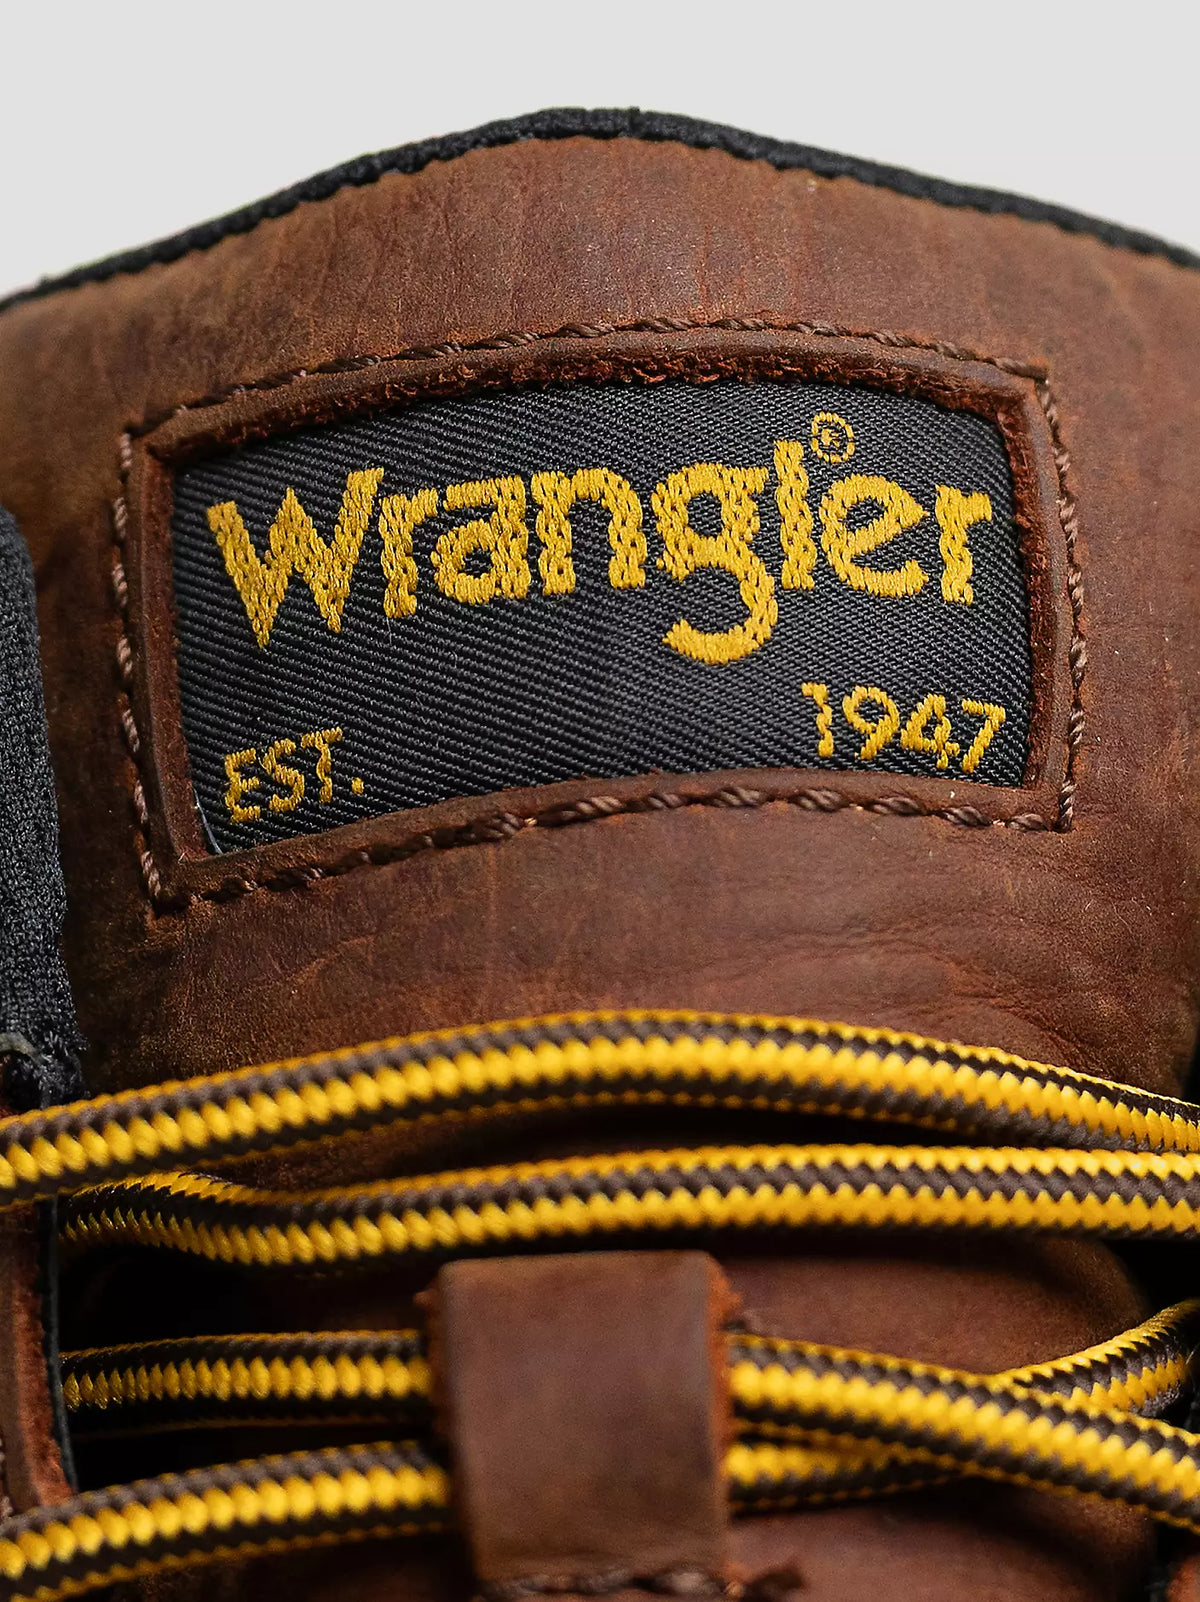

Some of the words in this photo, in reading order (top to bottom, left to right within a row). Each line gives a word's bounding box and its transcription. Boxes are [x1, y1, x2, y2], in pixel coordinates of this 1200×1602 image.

[207, 440, 992, 665] Wrangler
[224, 727, 365, 824] EST.
[801, 682, 1006, 773] 1947
